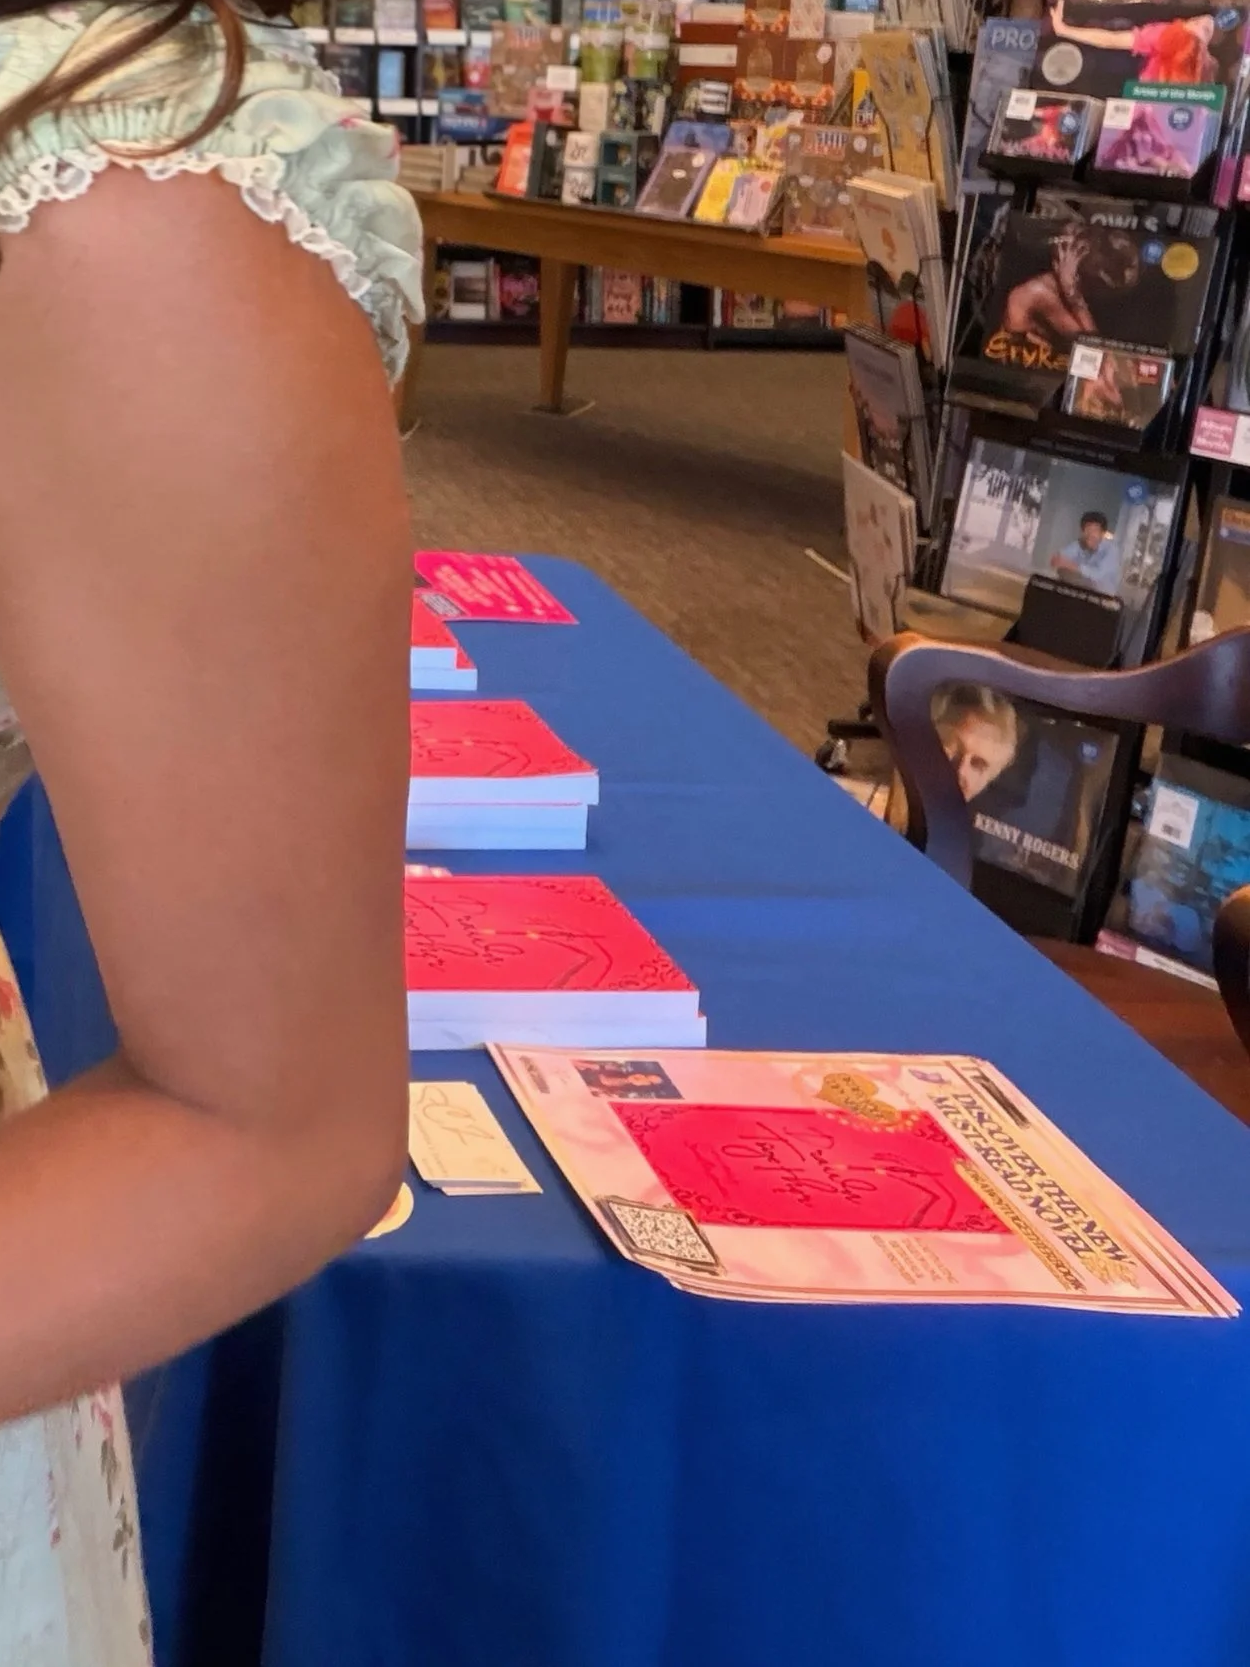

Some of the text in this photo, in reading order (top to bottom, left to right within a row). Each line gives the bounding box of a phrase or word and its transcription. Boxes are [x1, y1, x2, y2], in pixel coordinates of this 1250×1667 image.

[974, 812, 1081, 871] KENNY ROGERS
[931, 1094, 1097, 1260] MUST-READ NOVEL
[951, 1092, 1137, 1266] DISCOVER THE NEW
